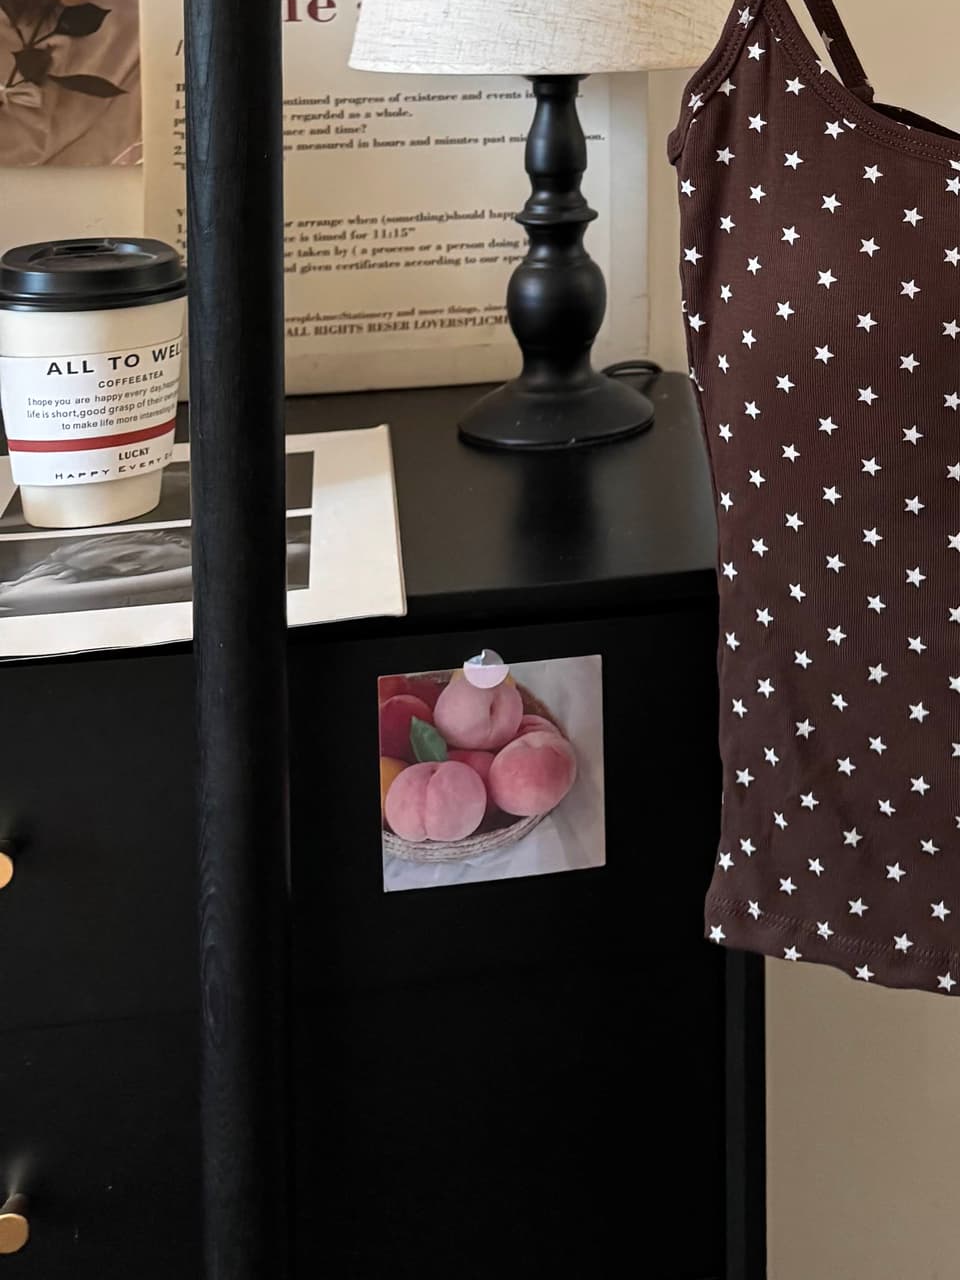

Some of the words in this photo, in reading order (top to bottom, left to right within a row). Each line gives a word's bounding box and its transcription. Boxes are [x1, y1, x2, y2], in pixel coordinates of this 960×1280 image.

[334, 95, 386, 108] progress
[388, 92, 402, 103] of
[403, 92, 458, 103] existence
[461, 90, 483, 101] and
[486, 90, 522, 100] events
[291, 109, 345, 122] regarded
[309, 125, 331, 136] and
[335, 123, 368, 135] time?
[296, 139, 354, 152] measured
[357, 138, 370, 149] in
[373, 137, 406, 148] hours
[410, 135, 431, 147] and
[434, 135, 480, 146] minutes
[483, 133, 505, 147] past
[297, 218, 344, 229] arrange
[347, 214, 378, 225] when
[313, 230, 347, 242] timed
[350, 229, 368, 240] for
[298, 245, 331, 258] taken
[334, 245, 348, 258] by
[371, 245, 416, 257] process
[418, 243, 432, 252] or
[446, 241, 485, 253] person
[488, 237, 521, 249] doing
[300, 261, 333, 275] given
[335, 258, 401, 271] certificates
[403, 254, 462, 269] according
[465, 255, 477, 265] to
[479, 254, 500, 264] our
[286, 325, 312, 337] ALL
[314, 323, 364, 336] RIGHTS
[367, 320, 410, 334] RESER
[46, 359, 96, 376] ALL
[107, 353, 140, 370] TO
[97, 369, 165, 389] COFFEE&TEA
[54, 399, 71, 408] you
[74, 396, 91, 405] are
[94, 391, 124, 404] happy
[124, 387, 148, 399] every
[26, 409, 41, 419] life
[42, 409, 50, 419] is
[108, 402, 131, 416] grasp
[132, 399, 141, 409] of
[73, 420, 98, 430] make
[99, 417, 115, 428] life
[116, 414, 134, 425] more
[55, 468, 111, 480] HAPPY
[118, 457, 162, 473] EVERY
